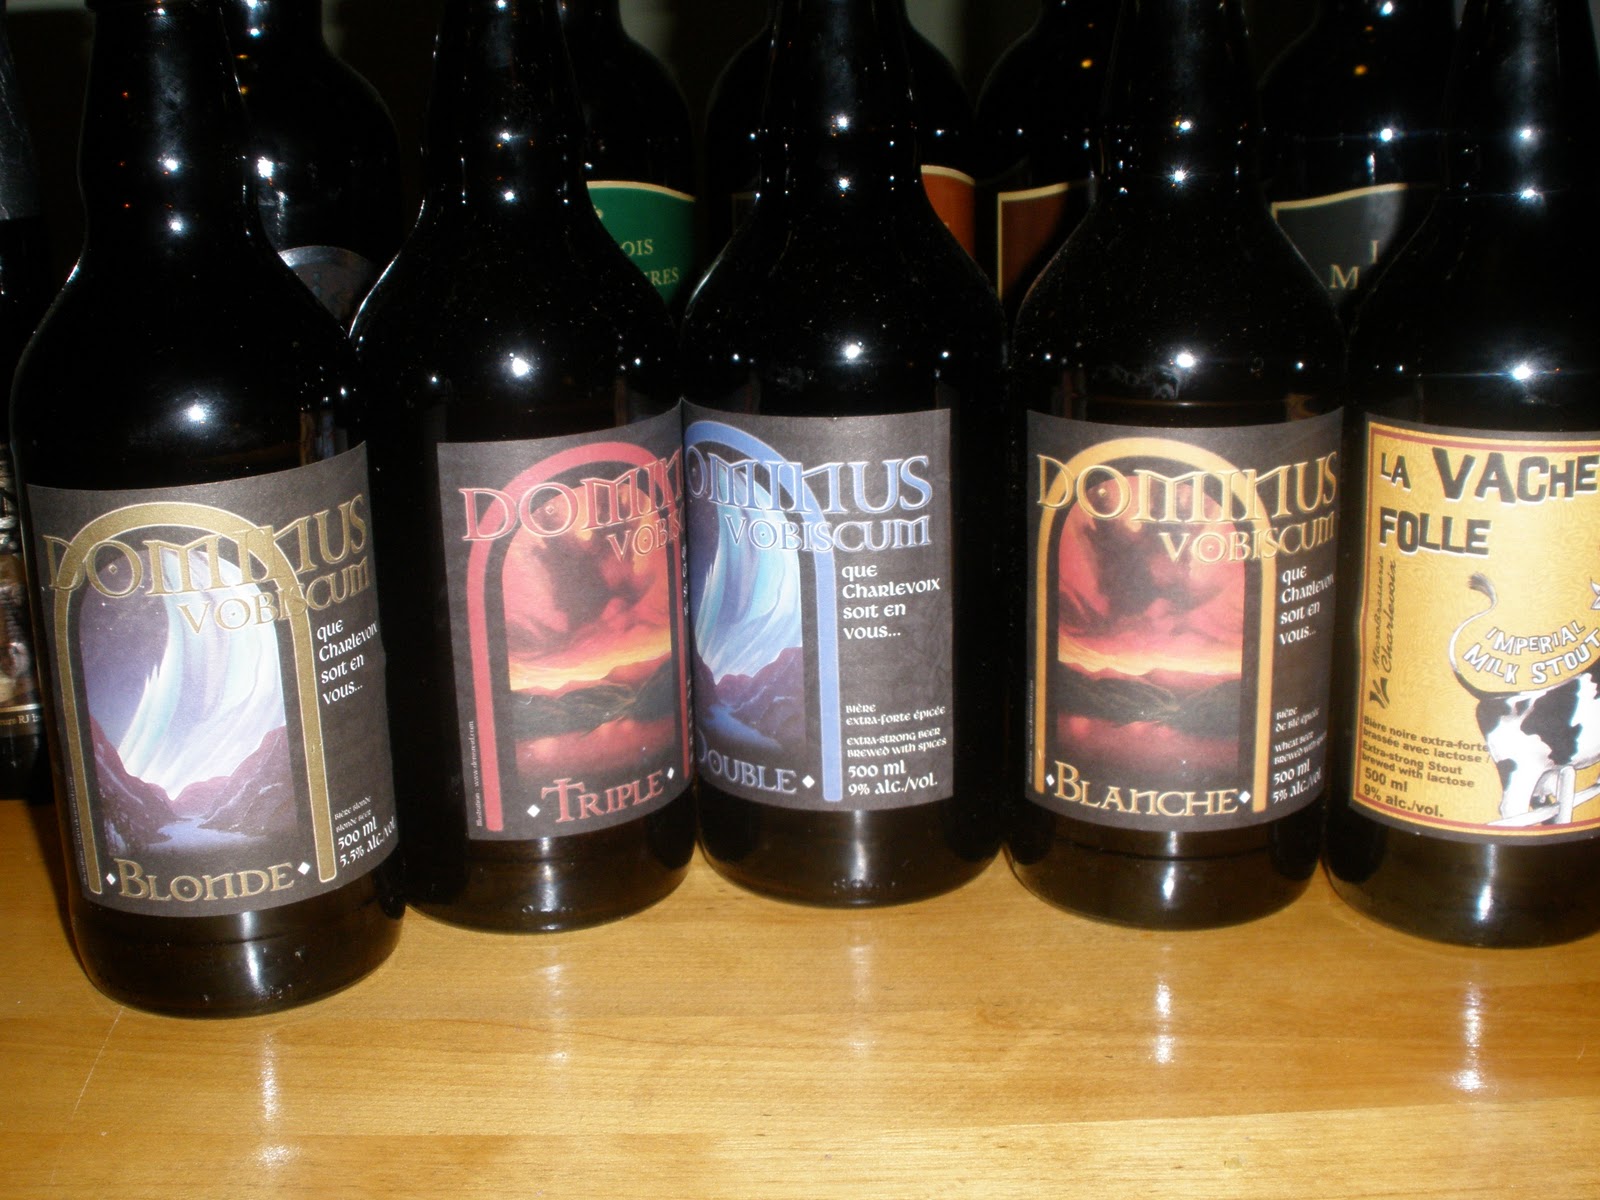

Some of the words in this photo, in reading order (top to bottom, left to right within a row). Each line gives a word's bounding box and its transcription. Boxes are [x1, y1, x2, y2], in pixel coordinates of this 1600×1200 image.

[1037, 451, 1337, 523] DOMINUS
[1380, 452, 1411, 491] LA
[1432, 447, 1600, 505] VACHE
[43, 494, 367, 597] DOMINUS
[725, 514, 932, 552] VOBISCUM
[1158, 511, 1335, 563] VOBISCUM
[1379, 506, 1491, 558] FOLLE
[841, 564, 878, 582] que
[842, 577, 940, 599] Charlevoix
[1282, 566, 1307, 586] que
[177, 556, 371, 634] VOBISCUM
[843, 604, 879, 620] soit
[883, 603, 906, 617] en
[316, 619, 344, 643] que
[1281, 606, 1306, 625] soit
[1485, 619, 1586, 656] IMPERIAL
[321, 661, 348, 684] soit
[350, 654, 364, 671] en
[1462, 642, 1520, 685] MILK
[1530, 627, 1600, 684] STOUT
[1363, 715, 1387, 733] Bière
[1389, 726, 1417, 741] noire
[1420, 735, 1489, 752] extra-forte
[1363, 727, 1400, 748] brassée
[1402, 742, 1430, 756] avec
[1434, 748, 1482, 763] lactose
[848, 764, 879, 778] 500
[883, 759, 907, 776] ml
[1273, 768, 1295, 785] 500
[1297, 758, 1310, 776] ml
[1362, 740, 1424, 770] Extra-strong
[1428, 761, 1462, 775] Stout
[1362, 752, 1396, 772] brewed
[1399, 766, 1423, 779] with
[1427, 772, 1475, 788] lactose
[540, 769, 664, 823] TRIPLE
[848, 783, 870, 796] 9%
[874, 772, 938, 795] alc./vol.
[1054, 760, 1238, 817] BLANCHE
[1272, 788, 1288, 804] 5%
[1365, 767, 1387, 785] 500
[1390, 779, 1408, 792] ml
[1364, 783, 1381, 801] 9%
[1385, 795, 1444, 817] alc./vol.
[338, 829, 360, 850] 500
[362, 816, 377, 837] ml
[340, 845, 364, 868] 5.5%
[113, 858, 295, 902] BLONDE
